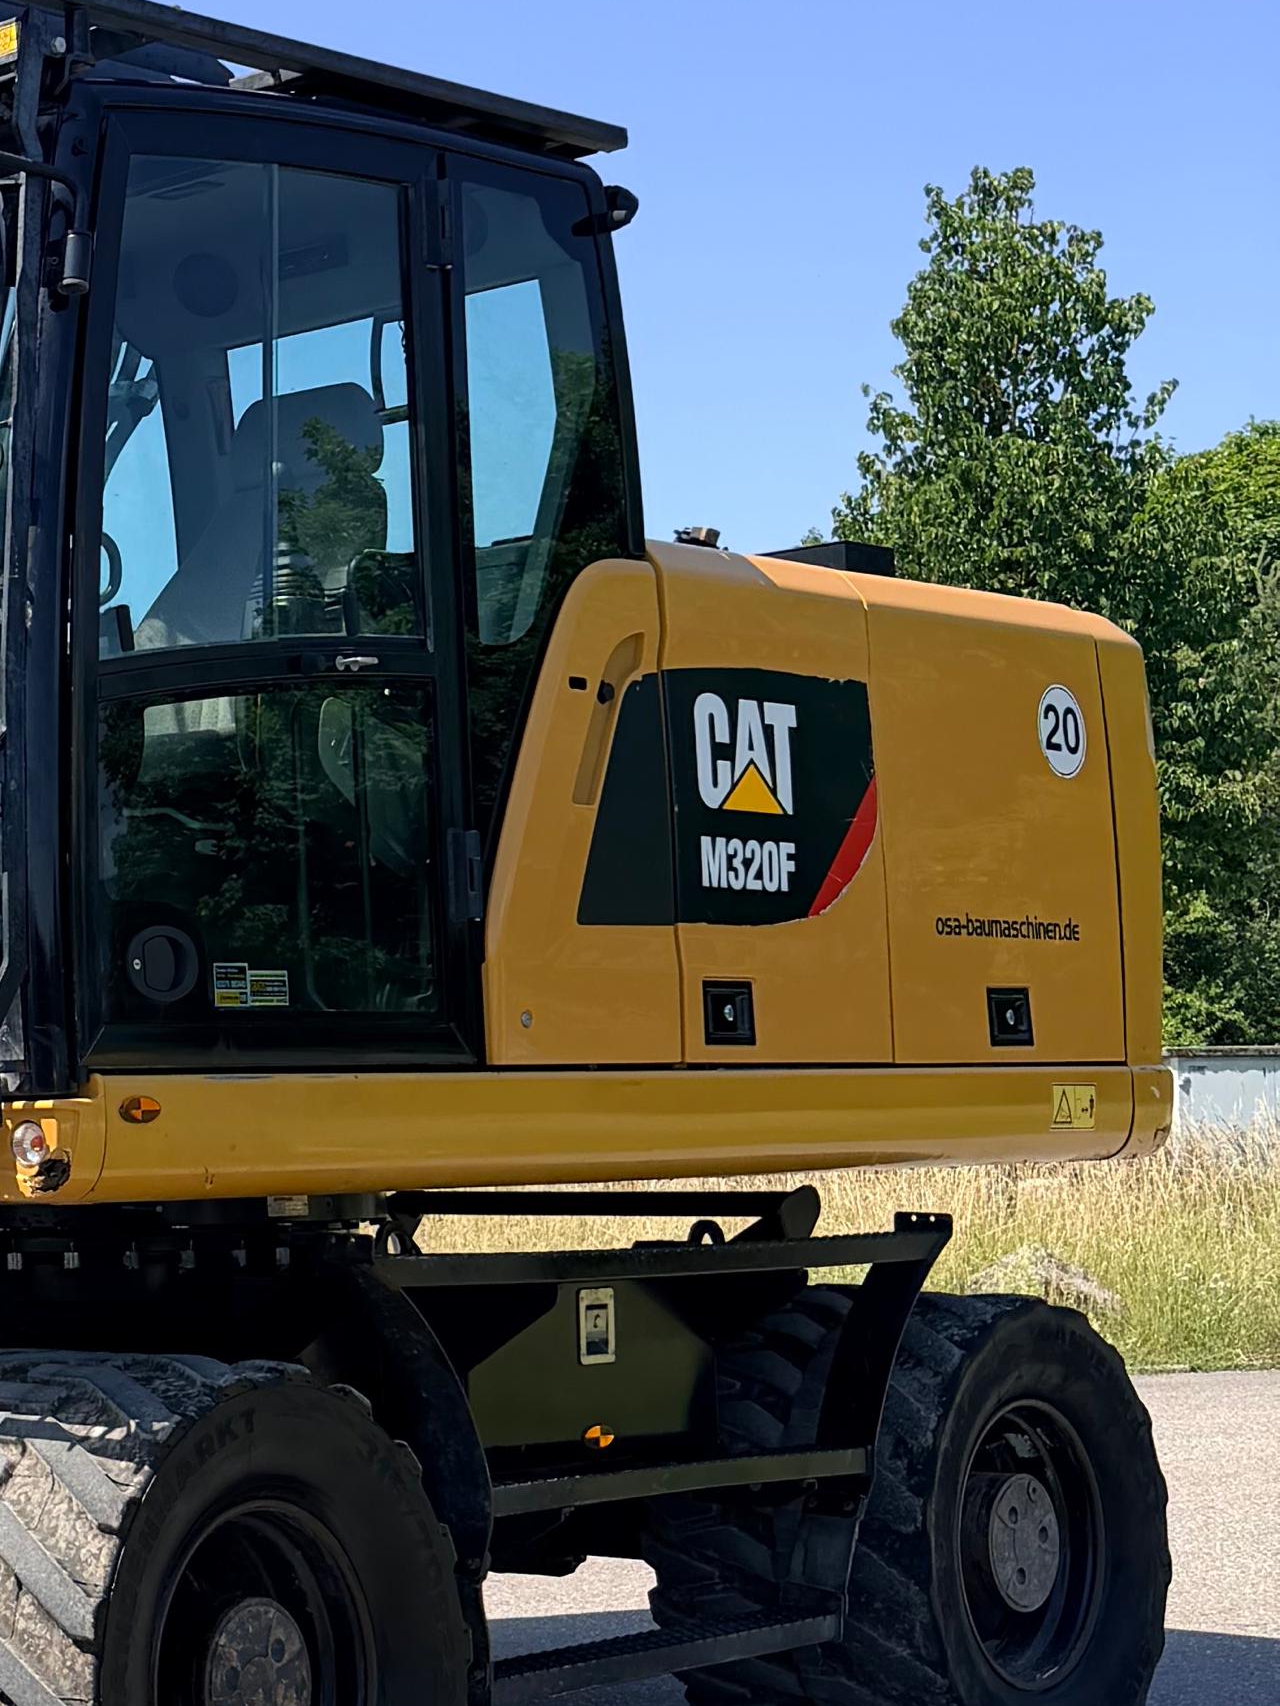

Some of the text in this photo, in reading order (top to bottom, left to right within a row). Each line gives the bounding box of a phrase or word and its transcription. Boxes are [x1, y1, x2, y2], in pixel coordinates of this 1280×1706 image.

[693, 691, 797, 816] CAT
[1042, 703, 1081, 757] 20
[699, 835, 797, 893] M320F
[935, 911, 1081, 942] osa-baumaschinen.de
